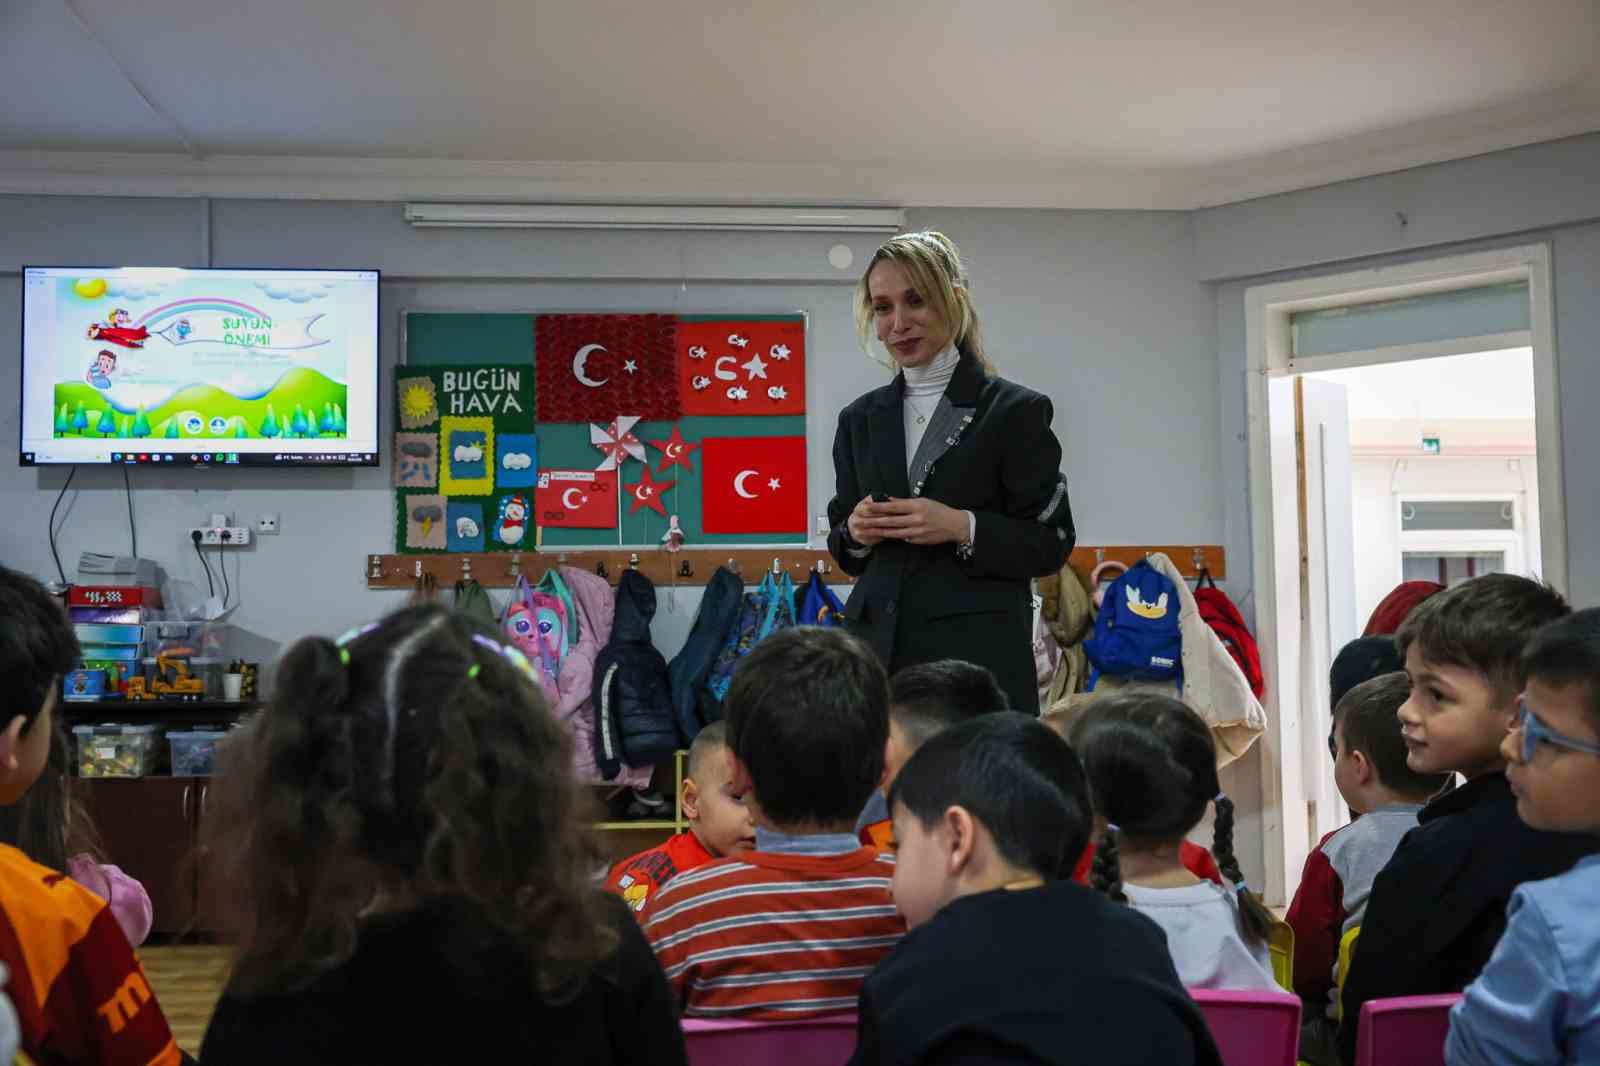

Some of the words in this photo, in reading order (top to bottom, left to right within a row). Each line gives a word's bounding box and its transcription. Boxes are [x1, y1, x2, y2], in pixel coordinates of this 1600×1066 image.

[443, 368, 521, 392] BUGÜN
[450, 392, 523, 415] HAVA
[1151, 656, 1175, 667] SONIC
